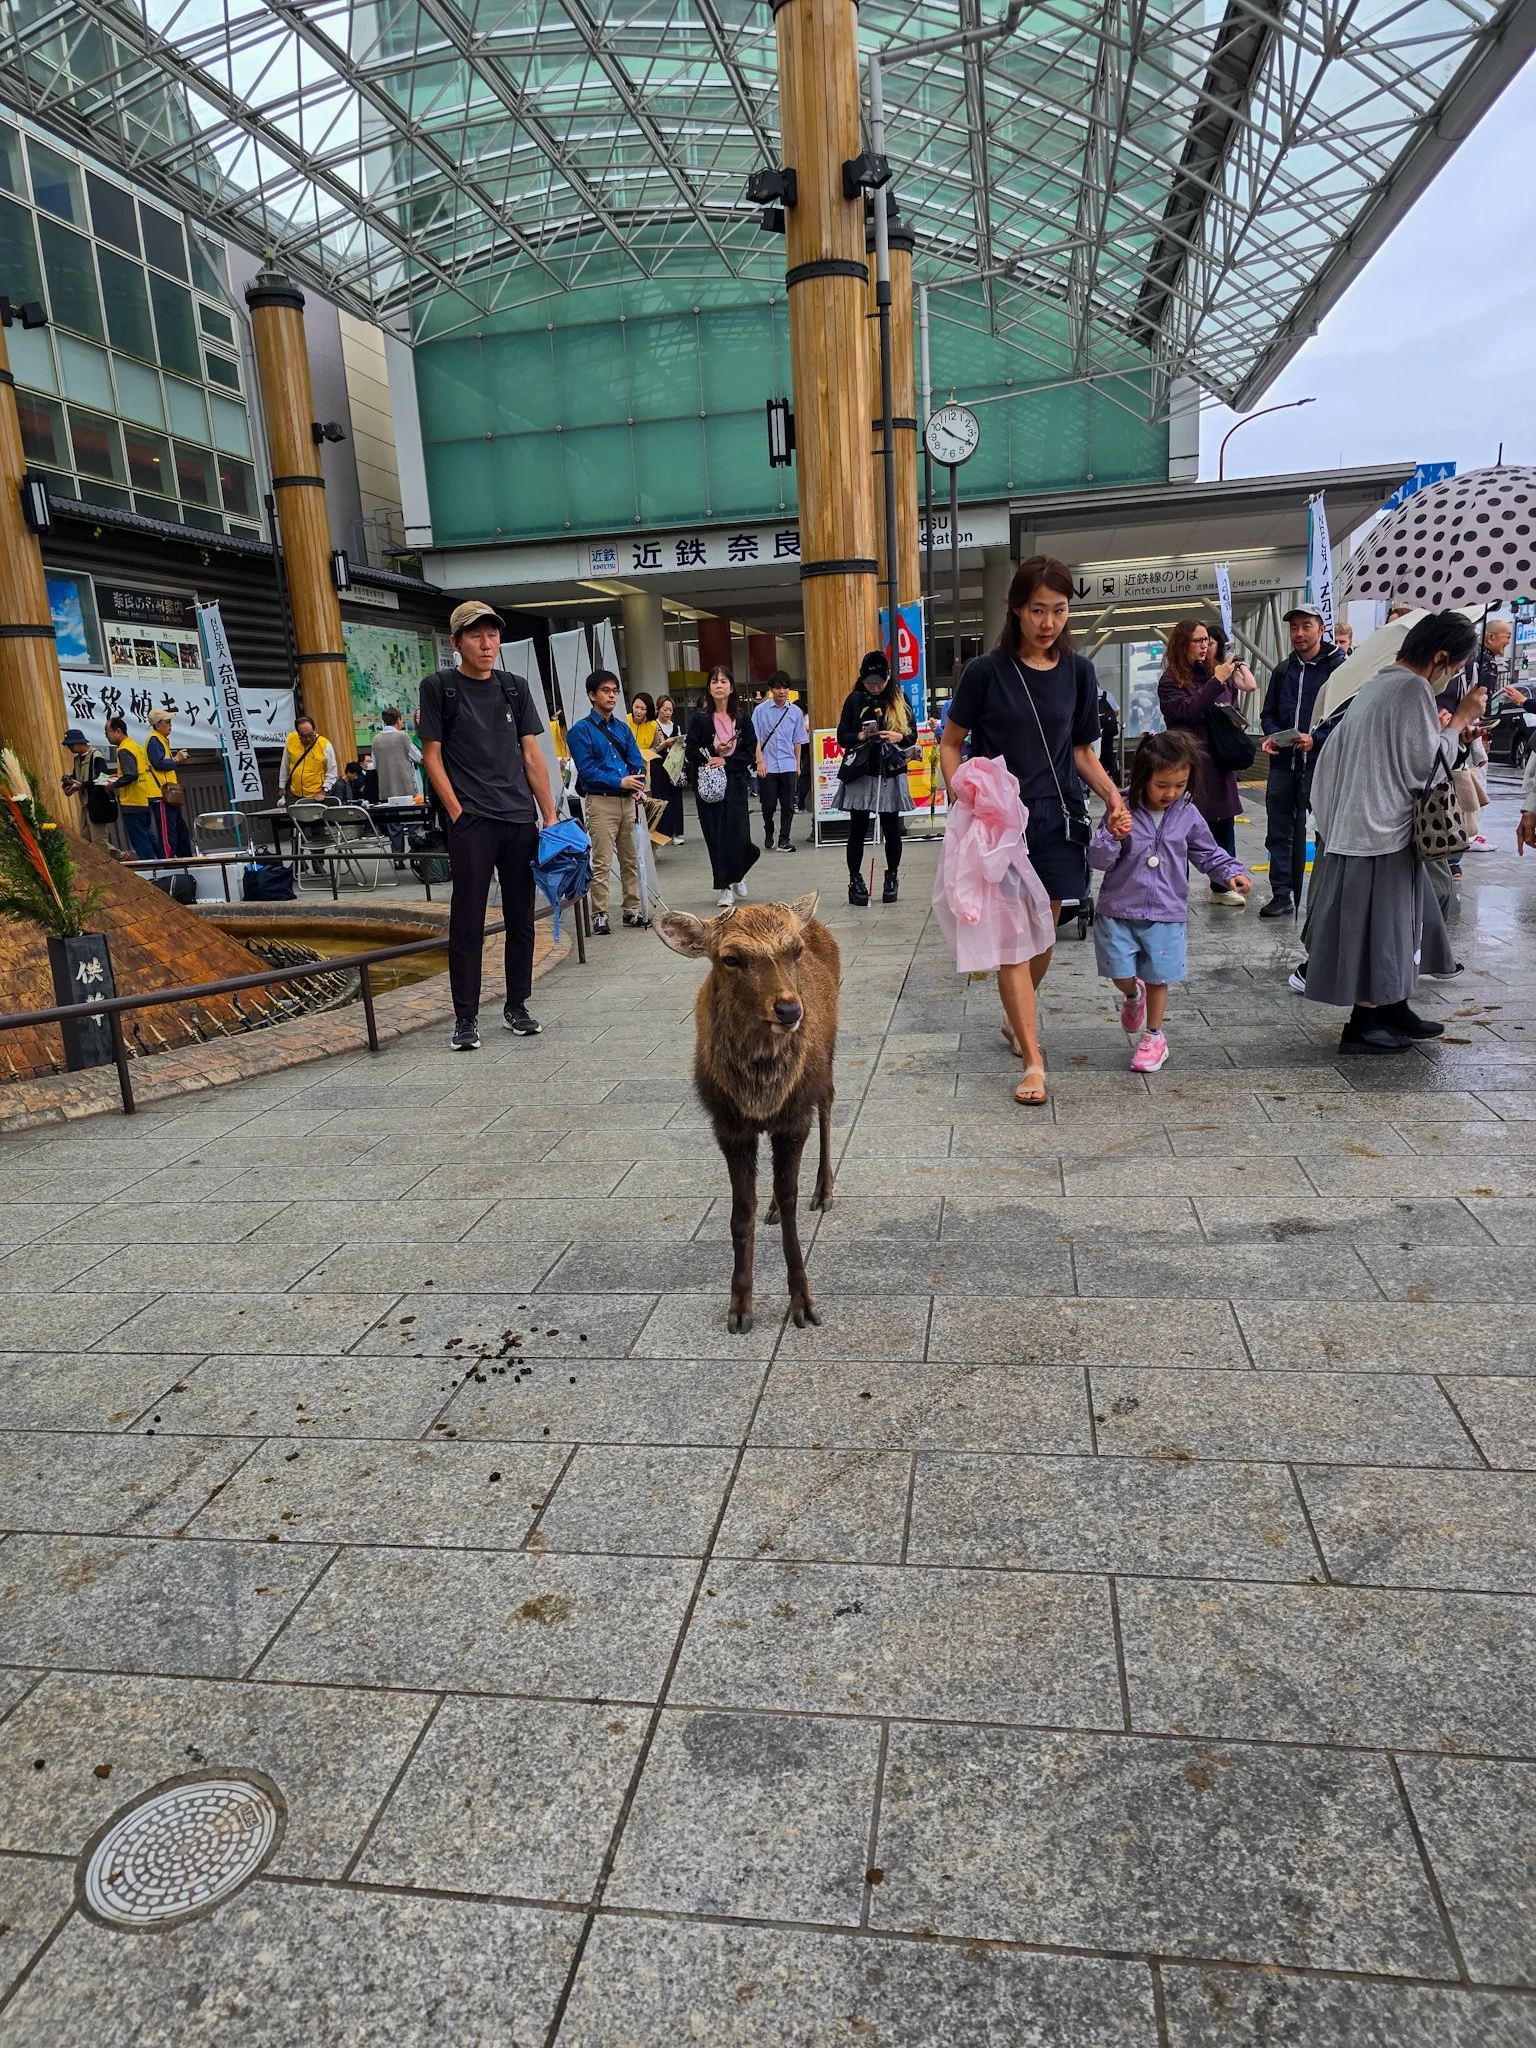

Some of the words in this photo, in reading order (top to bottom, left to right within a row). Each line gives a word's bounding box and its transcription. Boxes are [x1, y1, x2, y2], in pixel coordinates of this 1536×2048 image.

[940, 413, 948, 424] 11
[948, 412, 957, 421] 12
[932, 423, 942, 432] 10
[965, 419, 971, 428] 2
[931, 433, 937, 442] 9
[967, 429, 974, 437] 3
[934, 441, 941, 450] 8
[942, 448, 947, 457] 7
[950, 449, 956, 458] 6
[959, 446, 965, 455] 5
[633, 530, 800, 570] 近鉄奈良
[591, 548, 616, 563] 近鉄
[1124, 568, 1200, 586] 近鉄線のりば
[1275, 577, 1281, 585] 곳
[1124, 583, 1167, 597] Kintetsu
[1170, 579, 1191, 593] Line
[210, 617, 228, 660] NPO法人
[66, 681, 278, 728] 器移植キャンーン
[217, 663, 260, 793] 奈良県腎友会
